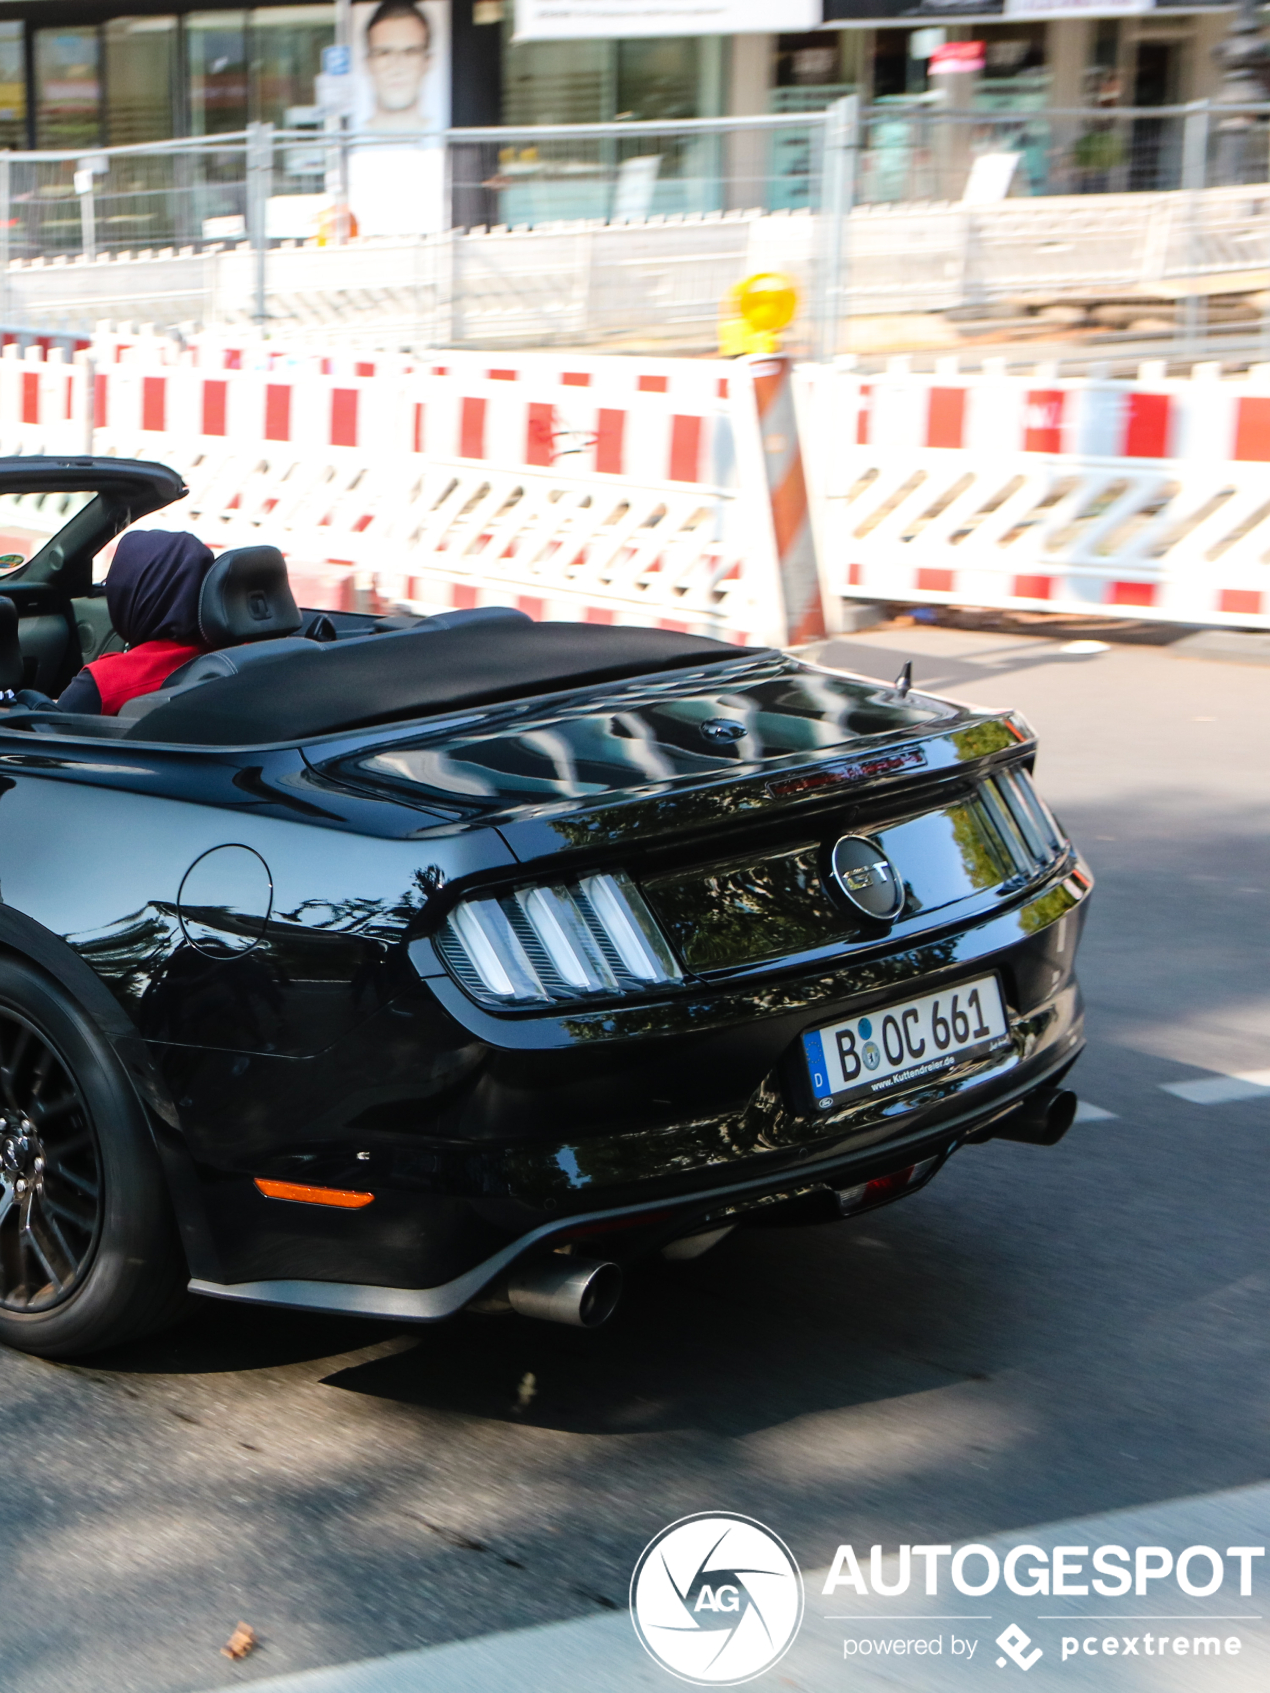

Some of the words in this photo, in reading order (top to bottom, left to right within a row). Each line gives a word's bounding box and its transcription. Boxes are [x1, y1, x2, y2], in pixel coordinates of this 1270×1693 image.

[842, 860, 889, 891] GT
[835, 1028, 862, 1083] B
[881, 1007, 926, 1067] OC
[931, 987, 991, 1051] 661
[814, 1072, 823, 1089] D
[870, 1055, 956, 1092] www.Kuttendreier.de
